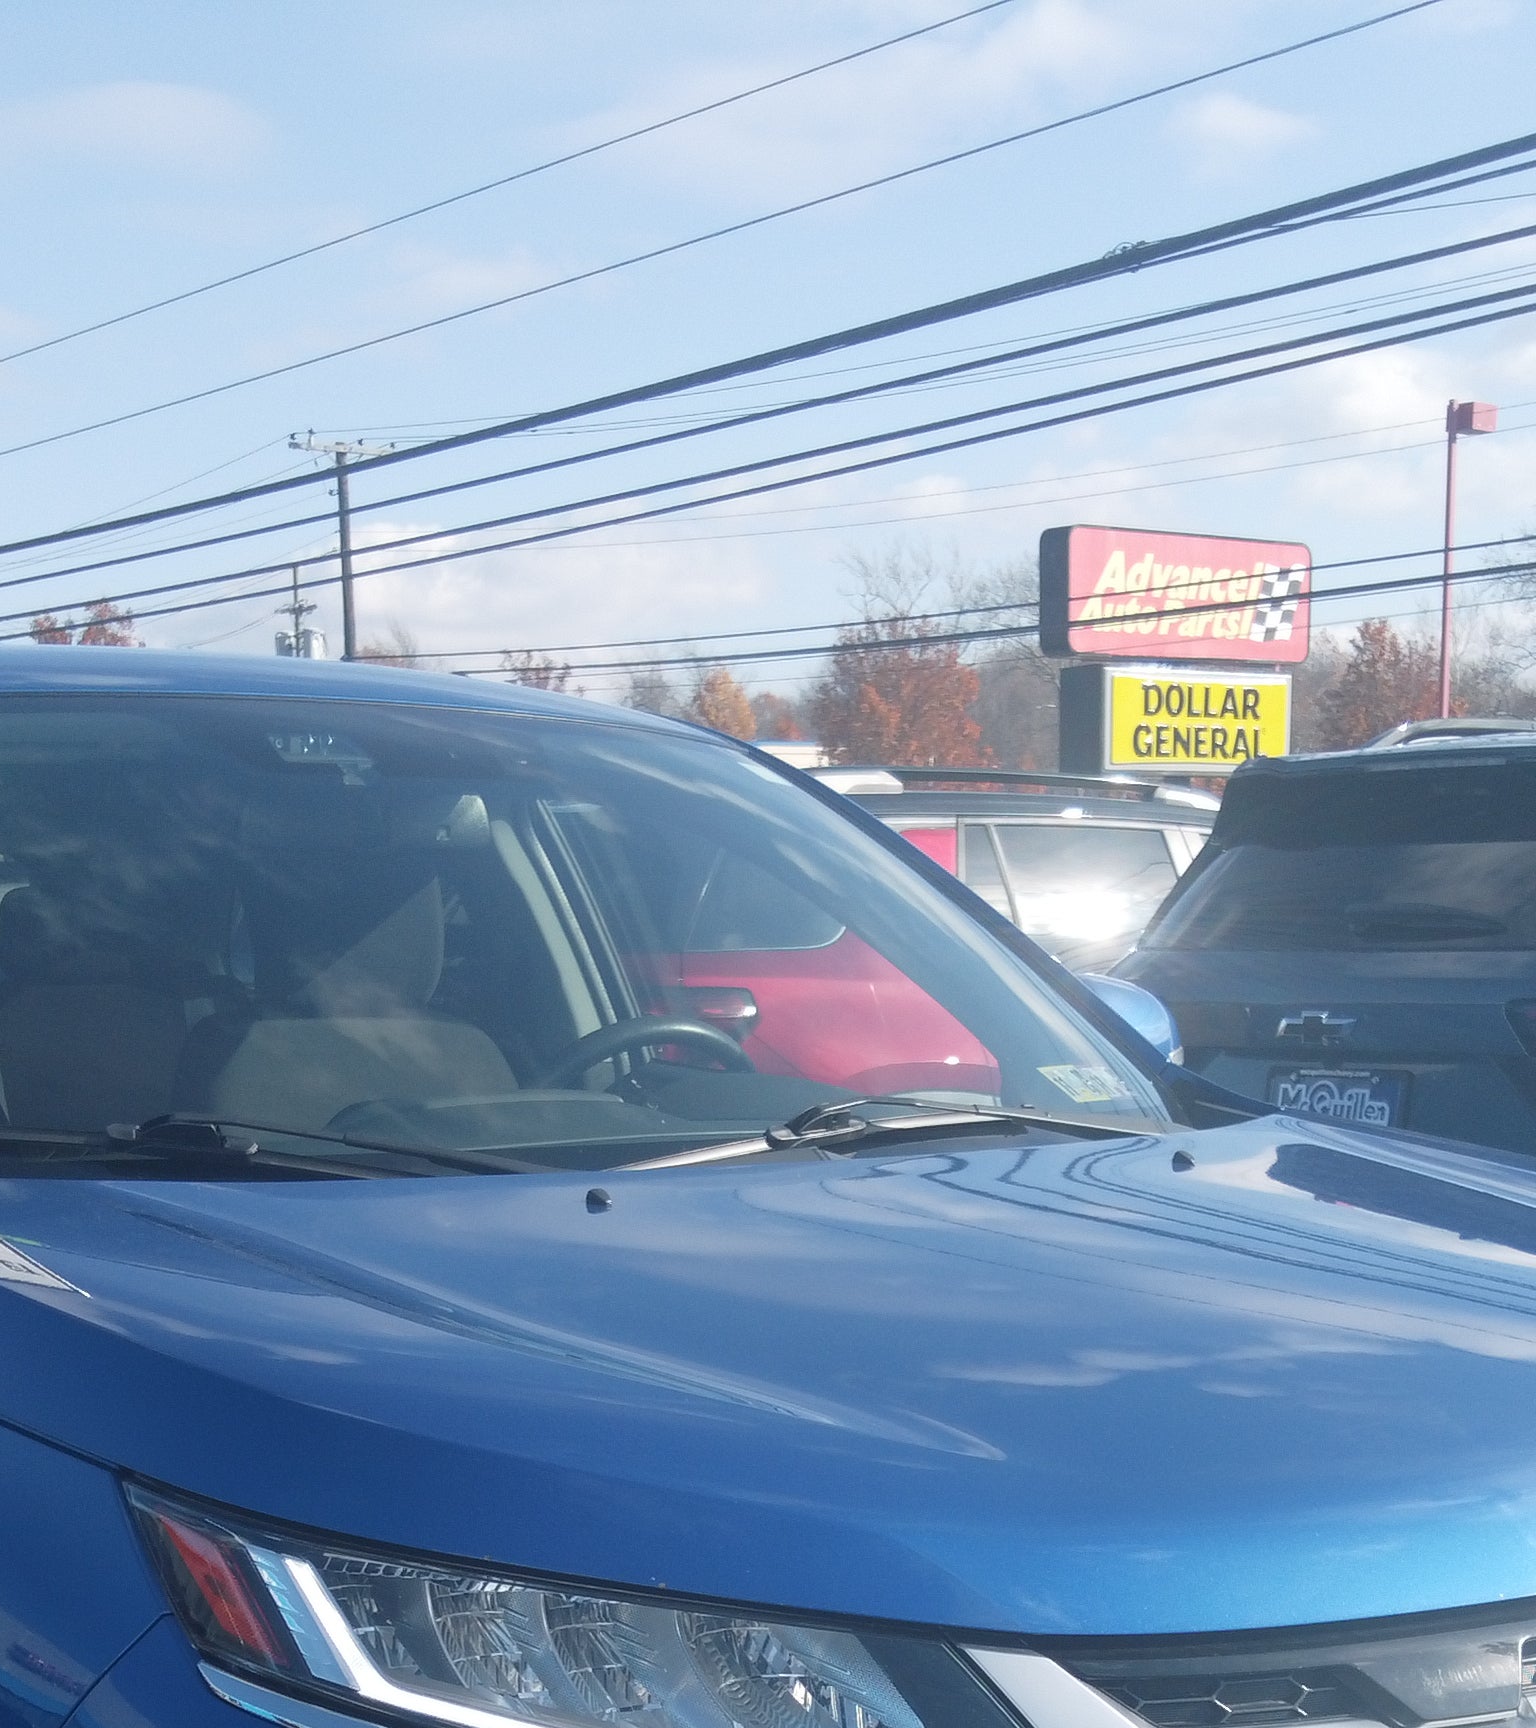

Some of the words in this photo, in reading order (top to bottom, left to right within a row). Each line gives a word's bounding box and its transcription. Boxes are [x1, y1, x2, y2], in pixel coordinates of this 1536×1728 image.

[1093, 550, 1248, 602] Advance
[1070, 598, 1156, 635] Auto
[1158, 600, 1246, 640] Parts
[1142, 681, 1260, 721] DOLLAR
[1133, 723, 1268, 760] GENERAL
